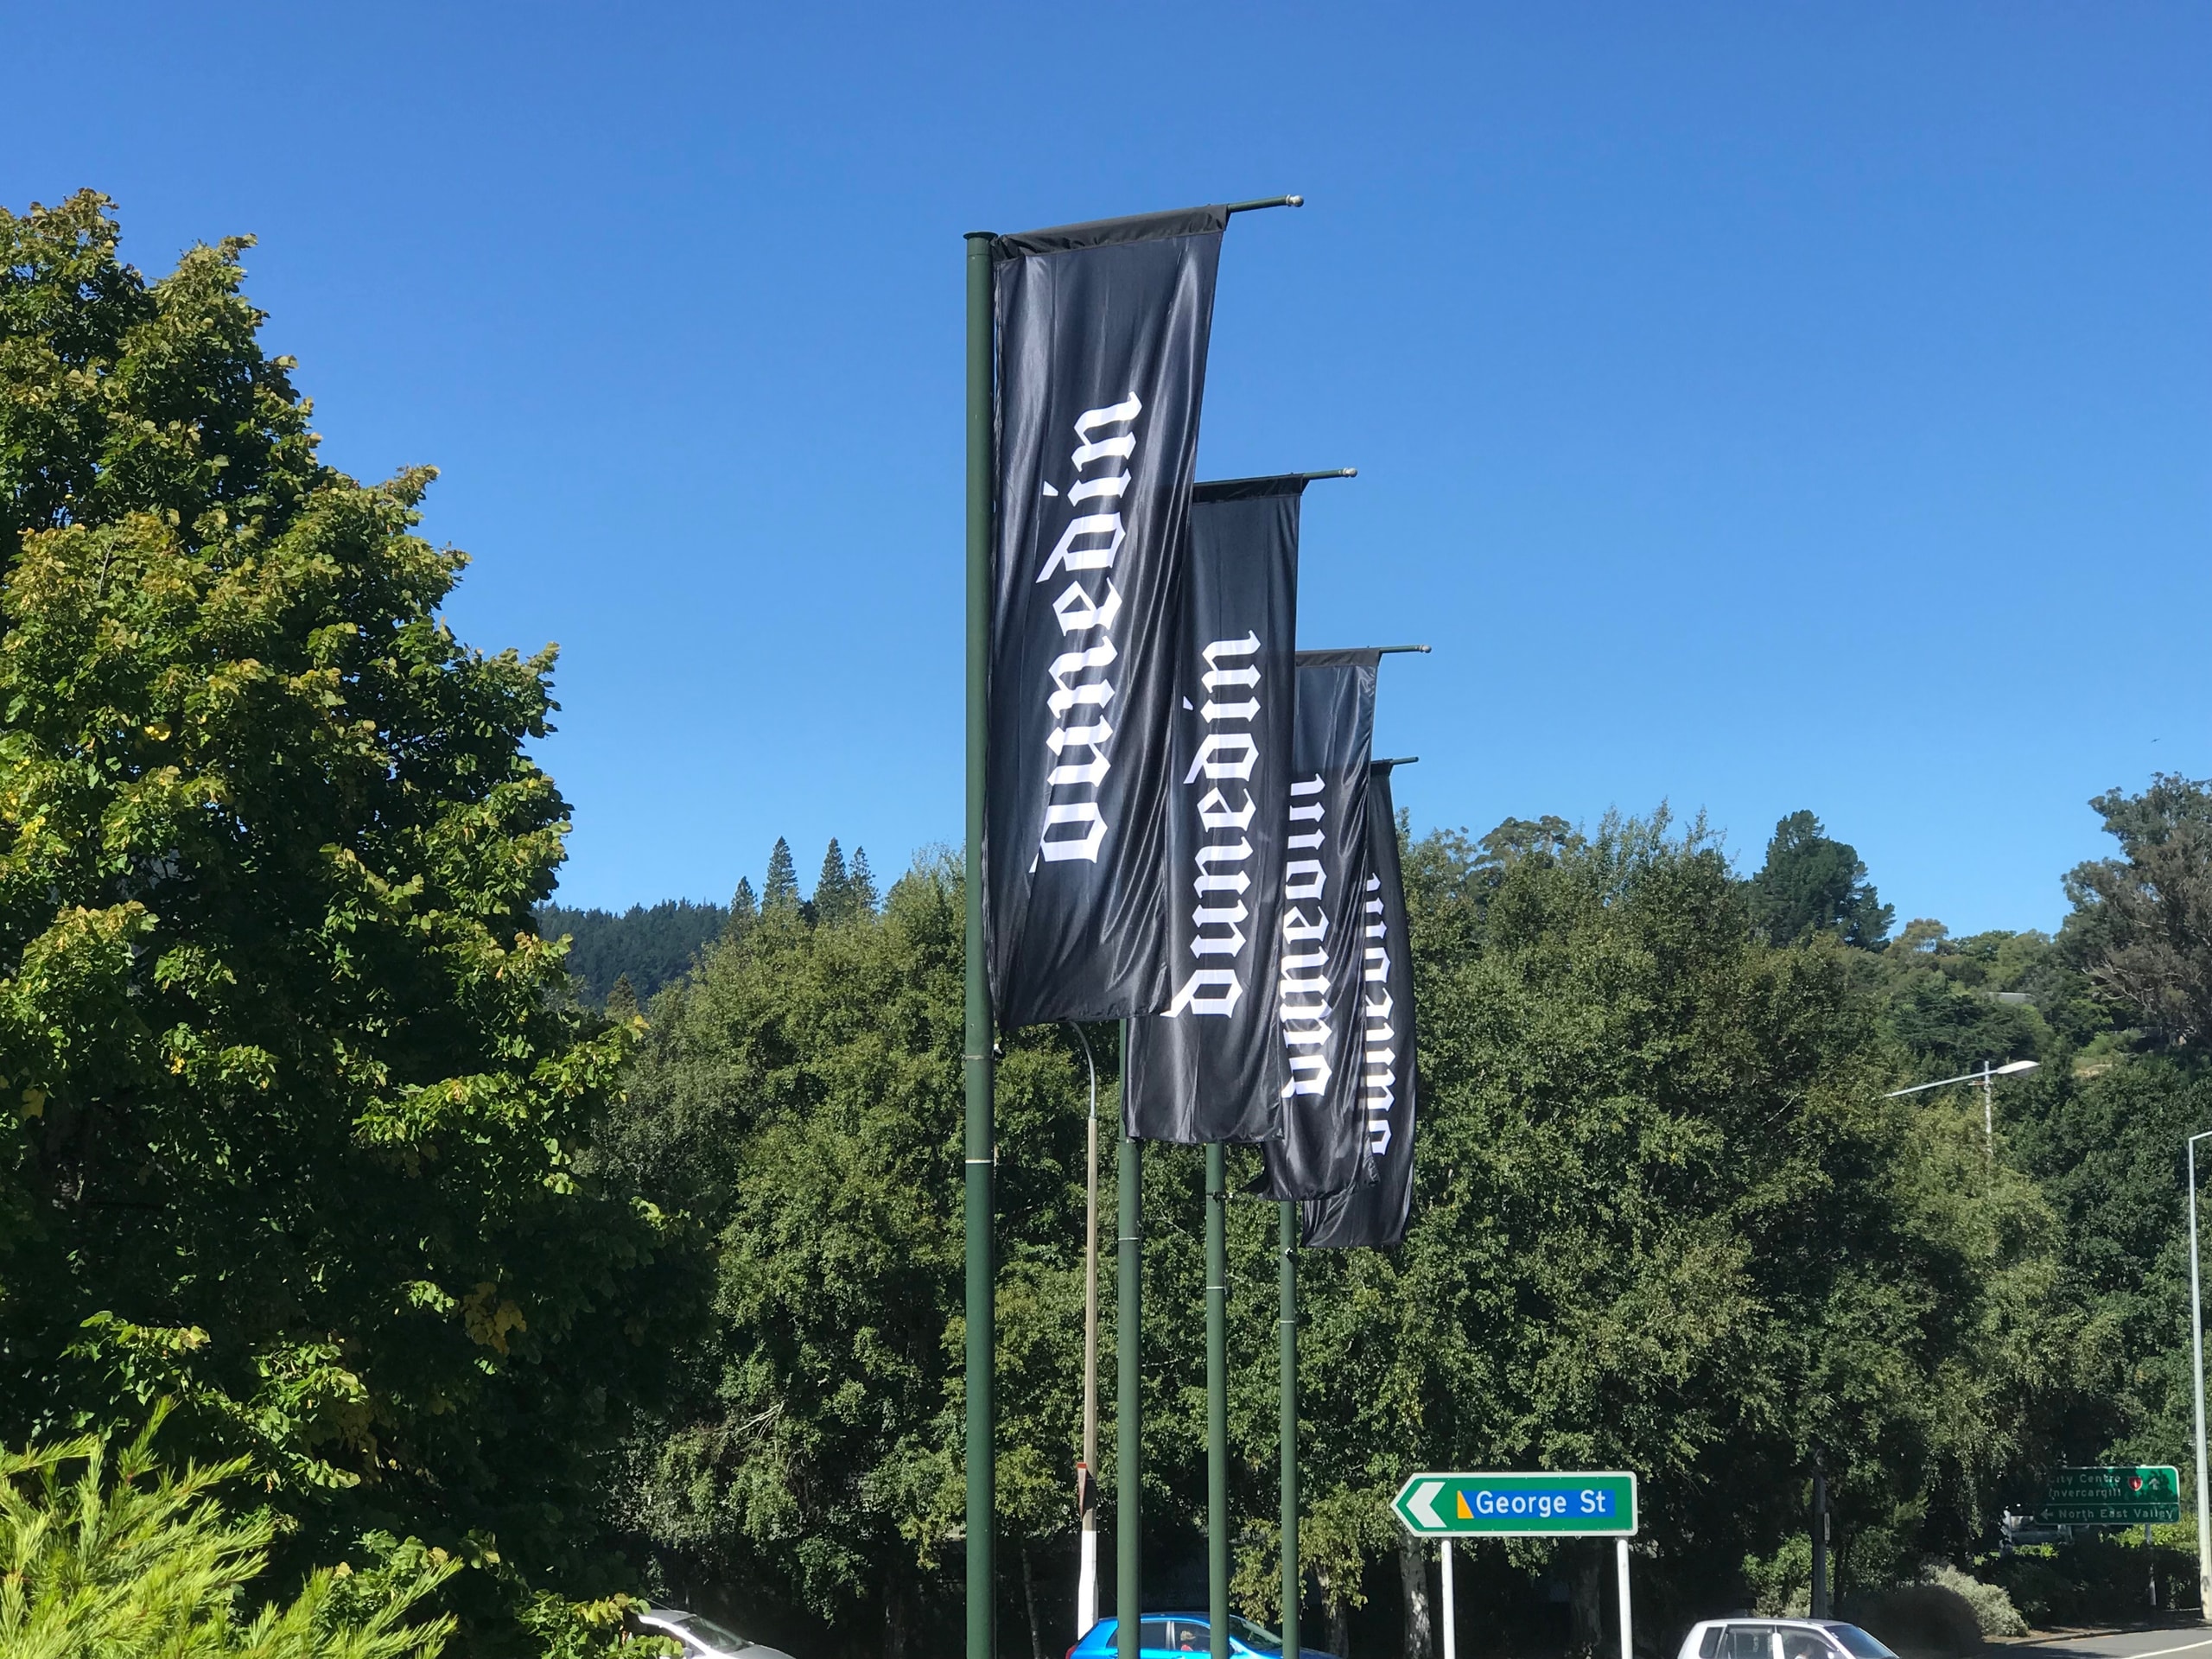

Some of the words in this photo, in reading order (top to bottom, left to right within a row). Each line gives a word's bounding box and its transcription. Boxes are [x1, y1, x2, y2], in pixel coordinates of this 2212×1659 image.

[2048, 1474, 2073, 1485] City
[2079, 1473, 2121, 1484] Centre
[2048, 1487, 2121, 1499] Invercargill
[1476, 1490, 1567, 1518] George
[1580, 1489, 1606, 1514] St
[2058, 1509, 2094, 1519] North
[2100, 1509, 2128, 1519] East
[2133, 1509, 2174, 1521] Valley
